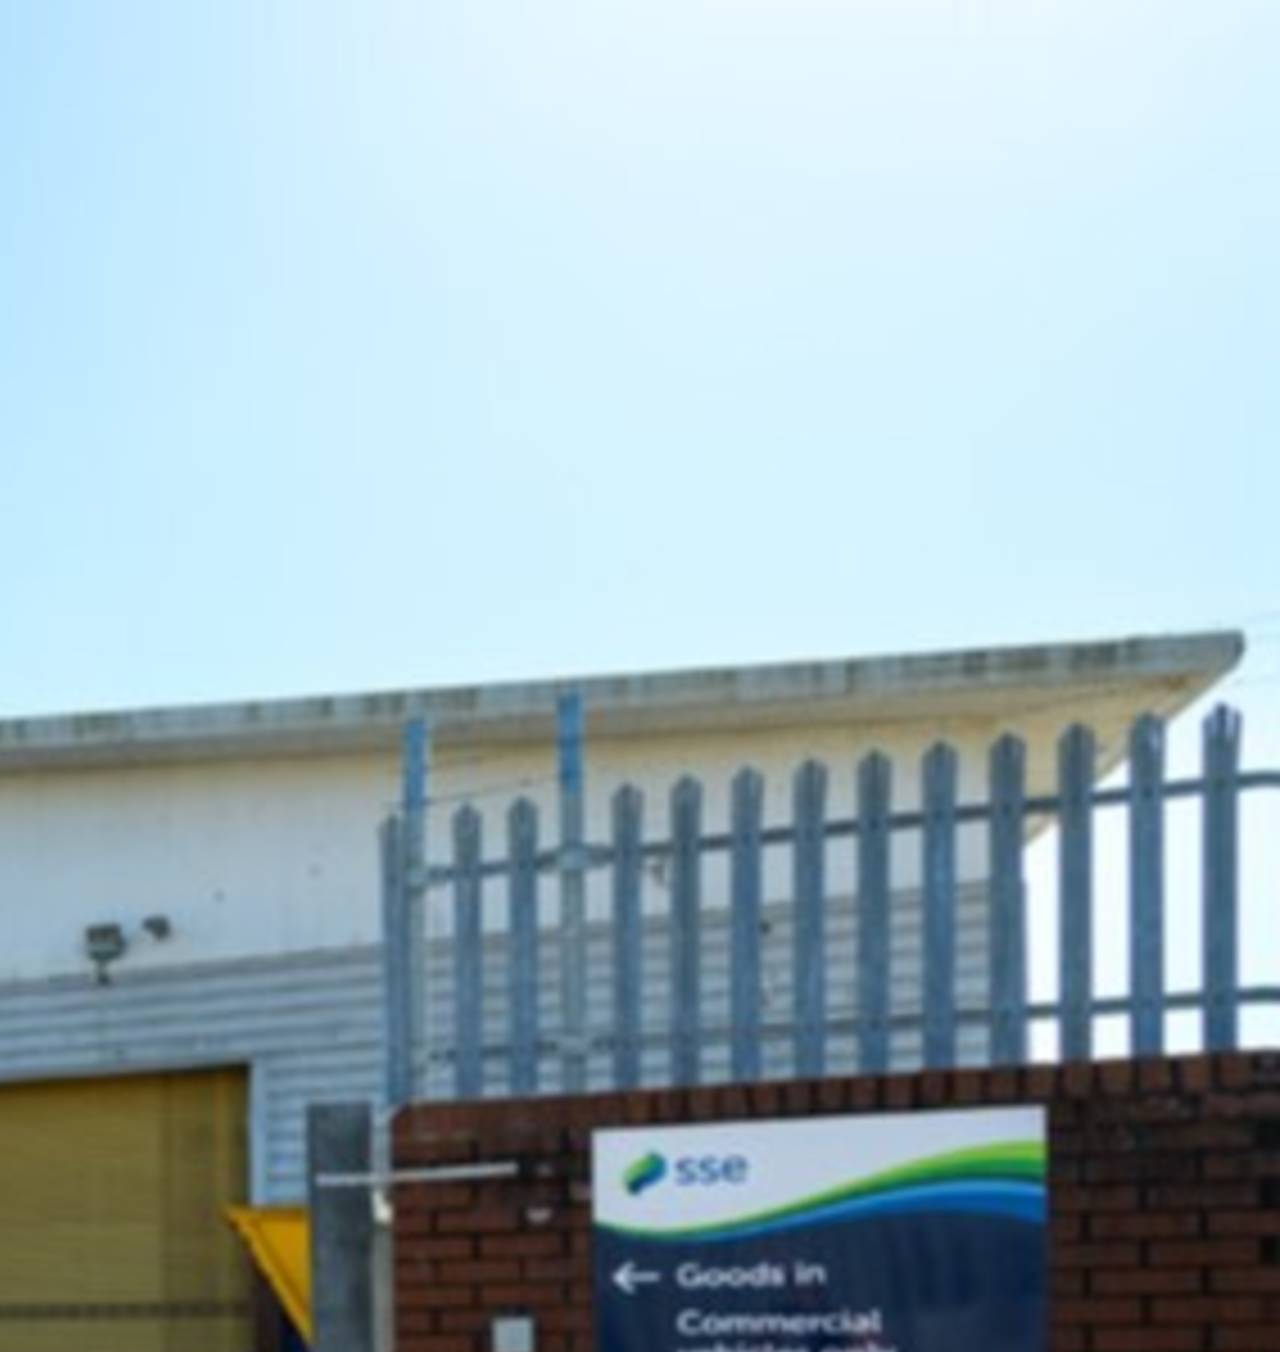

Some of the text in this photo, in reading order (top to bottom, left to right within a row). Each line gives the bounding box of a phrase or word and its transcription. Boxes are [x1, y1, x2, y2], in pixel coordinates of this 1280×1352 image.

[674, 1154, 748, 1184] sse
[676, 1261, 826, 1288] Goods in
[676, 1308, 882, 1336] Commercial
